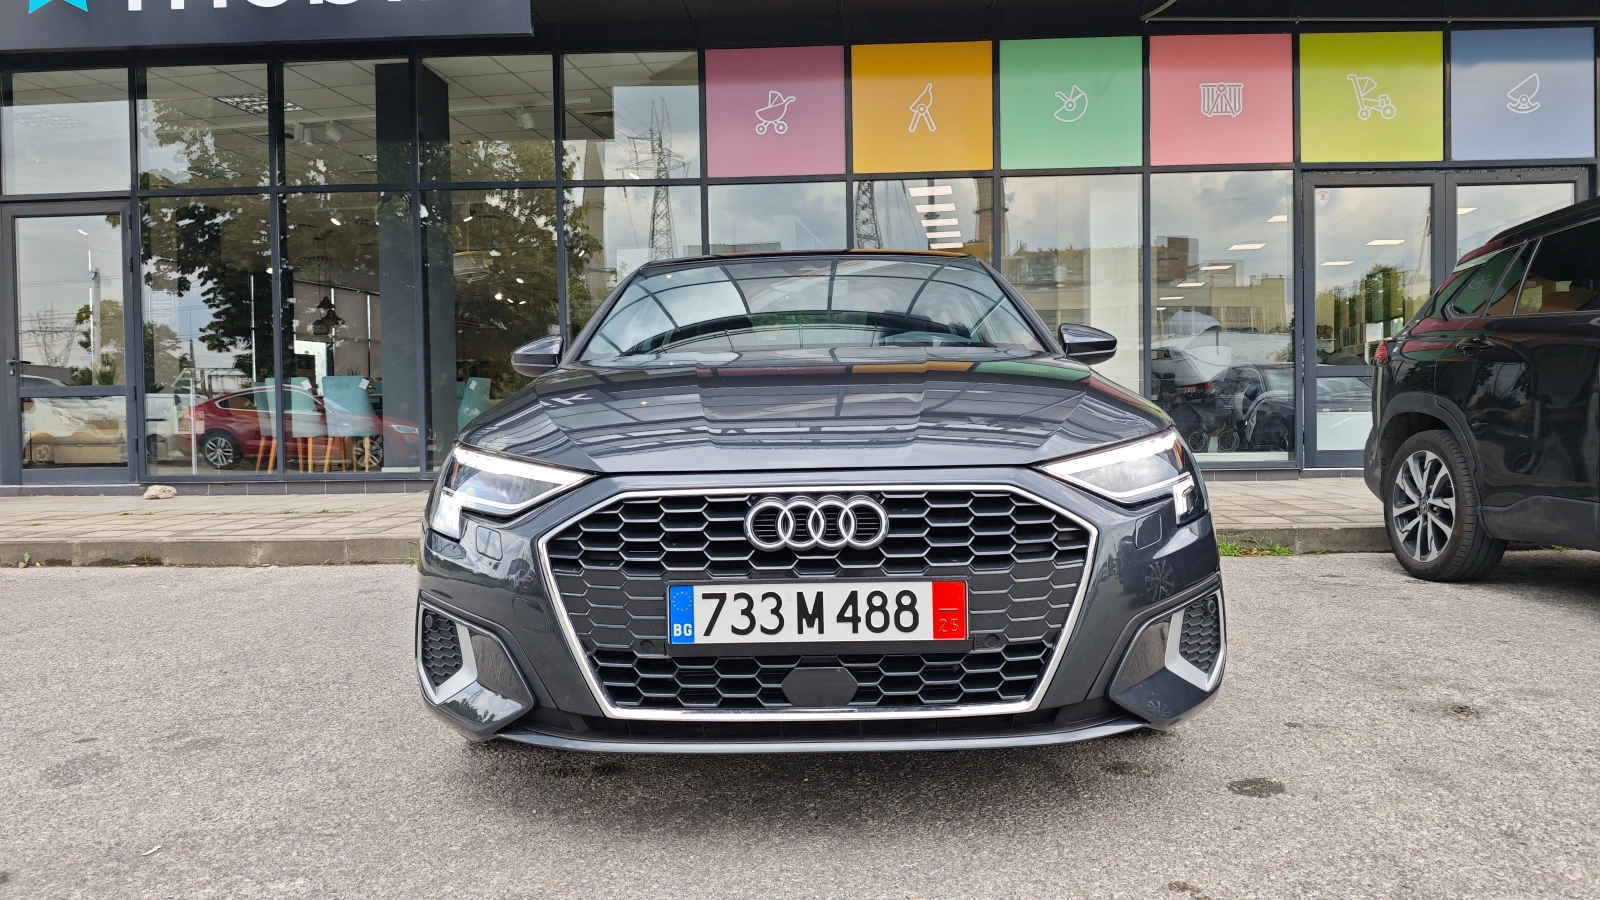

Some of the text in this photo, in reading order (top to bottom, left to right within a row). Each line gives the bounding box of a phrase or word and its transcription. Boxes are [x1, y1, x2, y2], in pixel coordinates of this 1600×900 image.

[702, 590, 919, 636] 733 M 488
[673, 623, 692, 637] BG
[939, 618, 959, 632] 25
